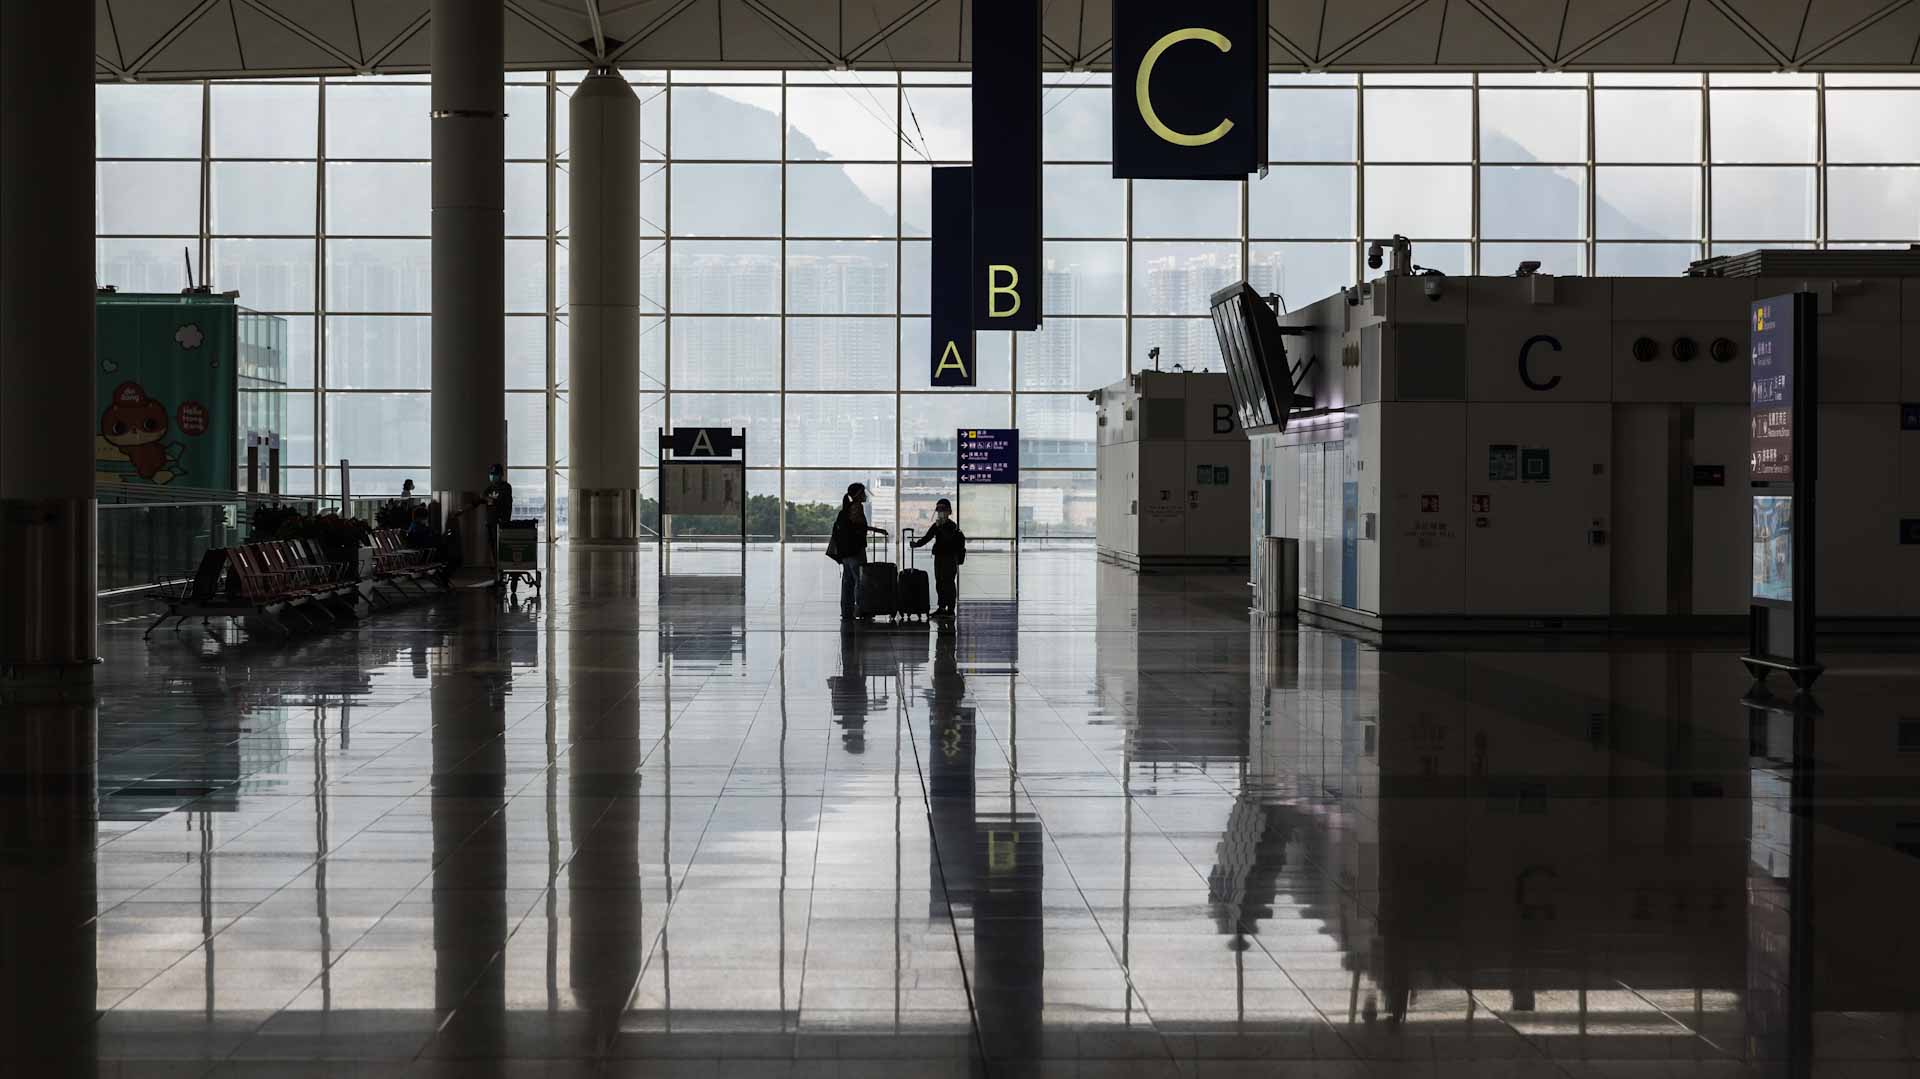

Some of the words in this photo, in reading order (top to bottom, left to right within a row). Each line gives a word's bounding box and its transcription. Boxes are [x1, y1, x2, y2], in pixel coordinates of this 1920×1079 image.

[1136, 28, 1234, 146] C
[988, 265, 1021, 318] B
[934, 340, 970, 379] A
[1518, 335, 1562, 391] C
[1213, 404, 1234, 434] B
[690, 429, 715, 456] A
